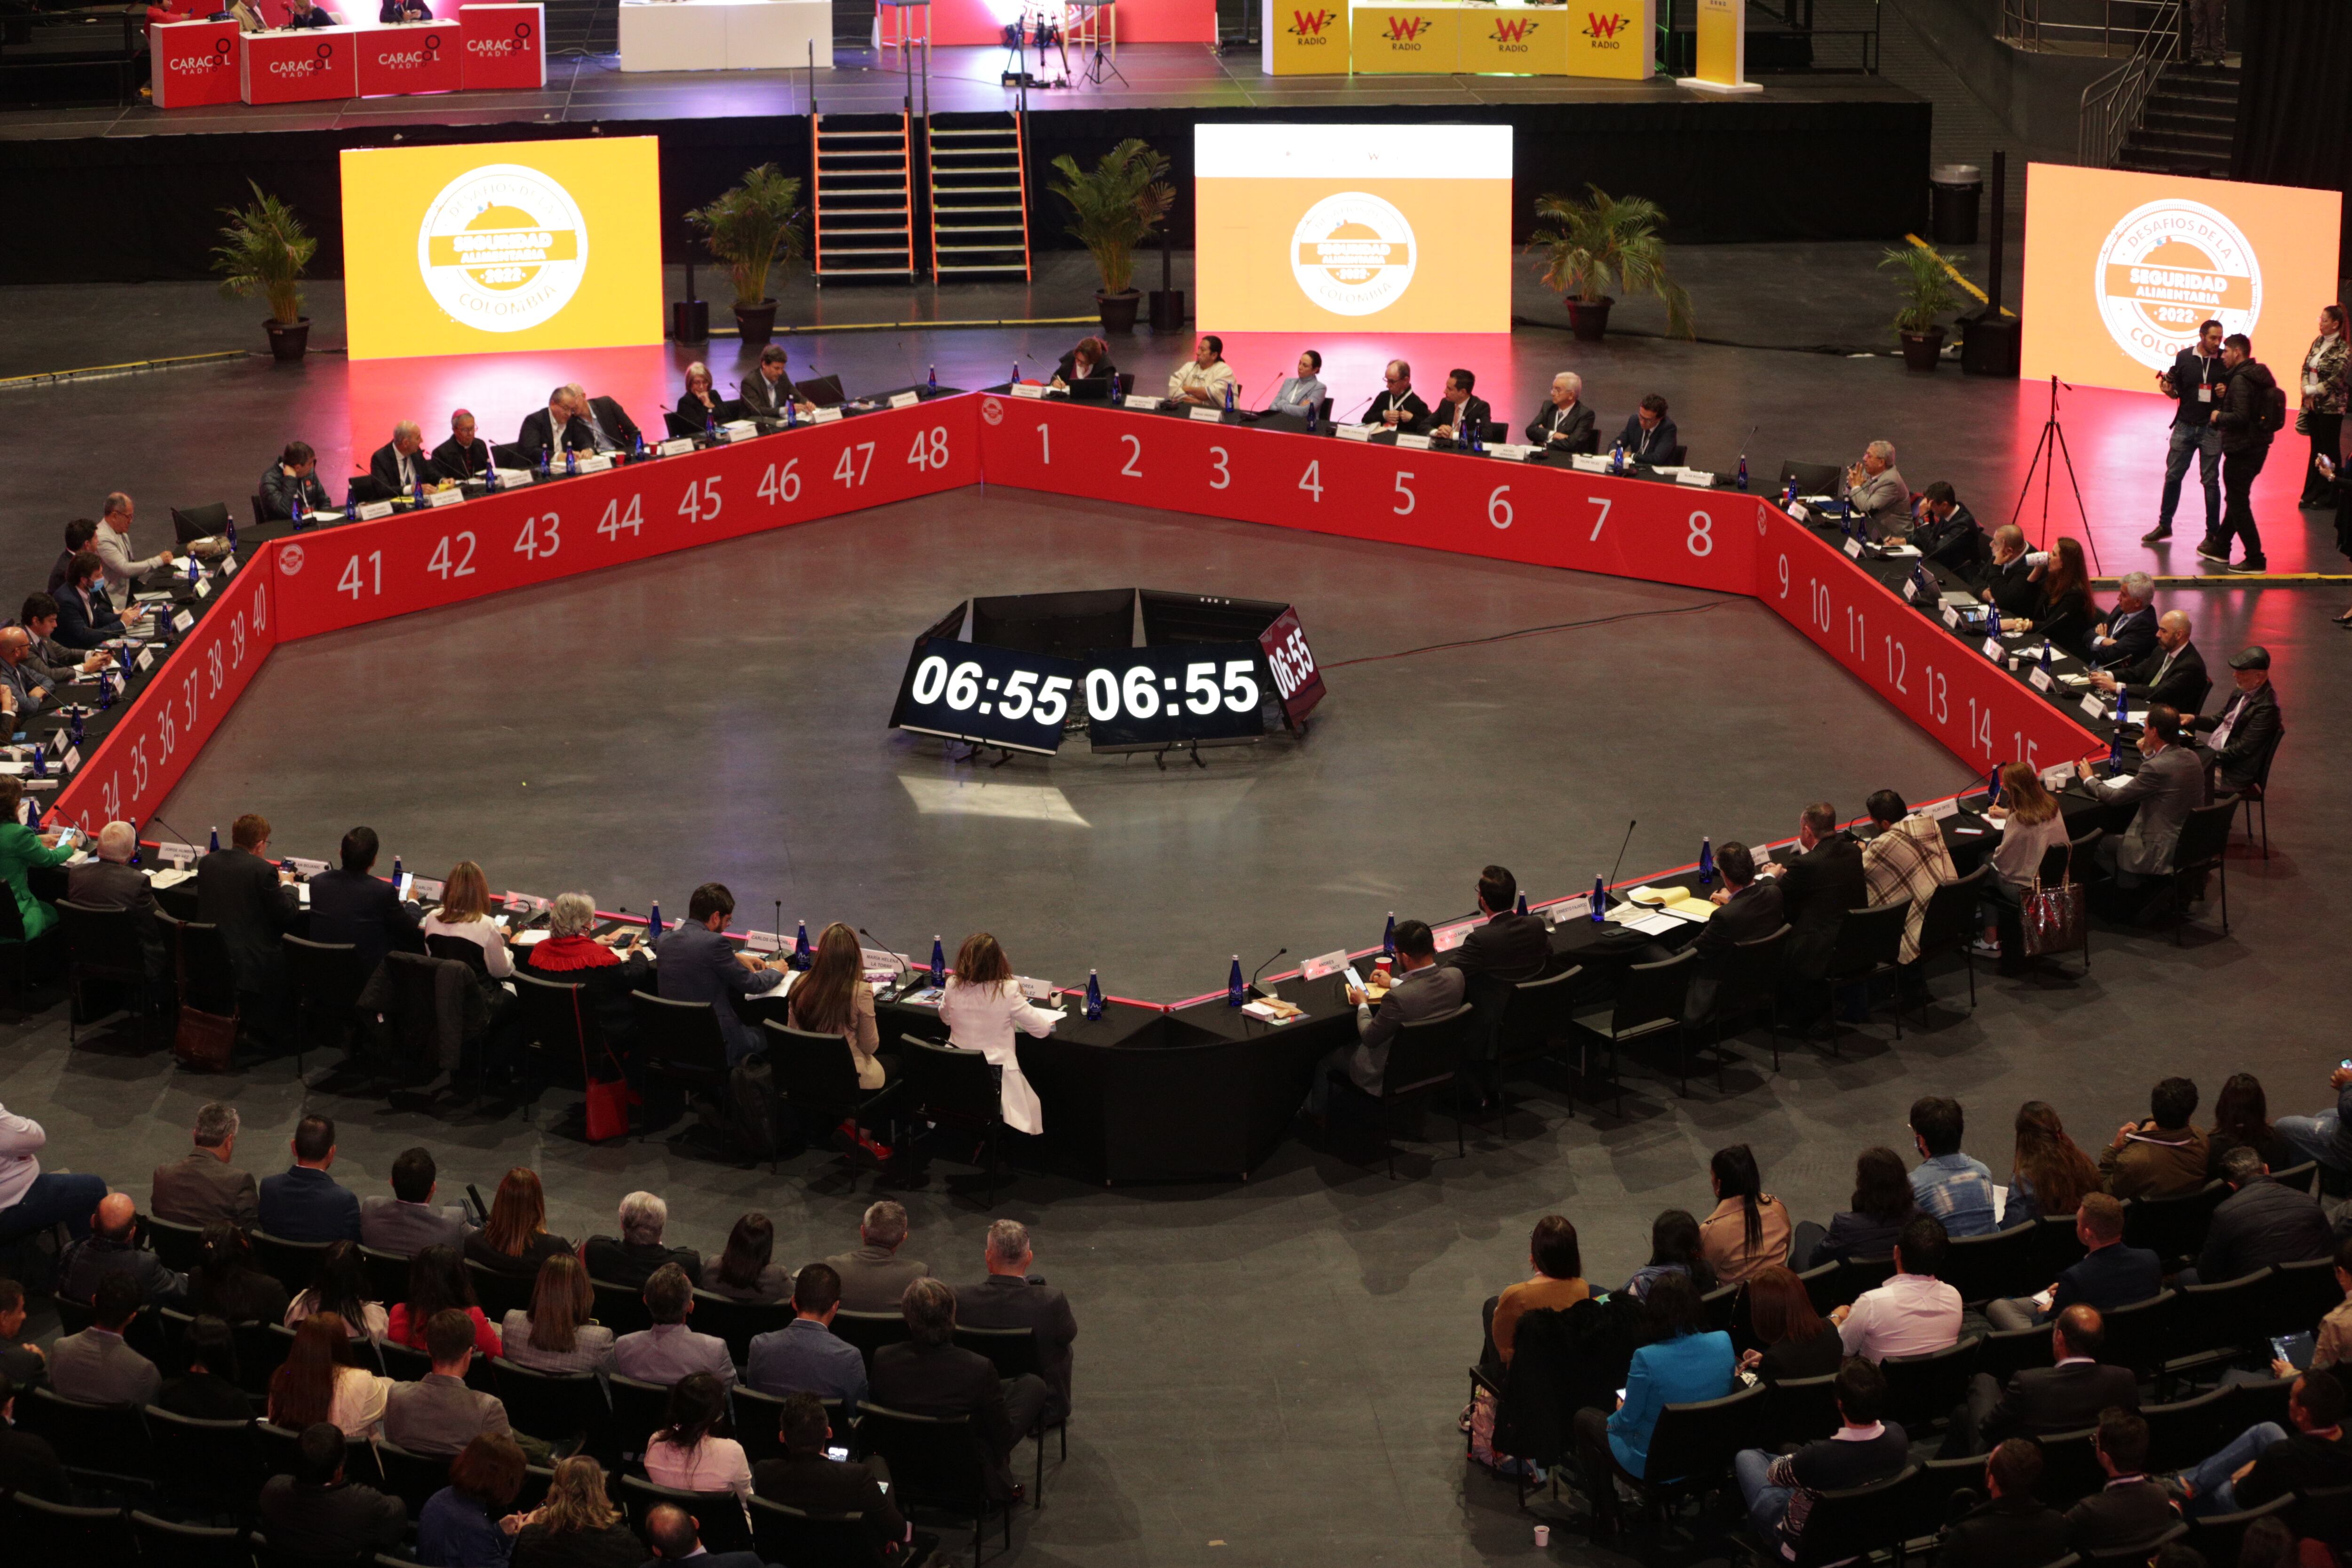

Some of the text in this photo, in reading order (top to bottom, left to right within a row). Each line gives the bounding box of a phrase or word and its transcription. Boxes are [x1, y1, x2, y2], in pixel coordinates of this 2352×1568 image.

[1294, 9, 1325, 35] W
[1298, 37, 1327, 46] RADIO
[1389, 16, 1421, 41] W
[1495, 18, 1527, 43] W
[1589, 12, 1620, 39] W
[170, 54, 230, 70] CARACOL
[270, 59, 332, 73] CARACOL
[379, 50, 440, 65] CARACOL
[467, 39, 530, 51] CARACOL
[1592, 40, 1620, 50] RADIO
[2198, 225, 2214, 240] DE
[2215, 237, 2233, 259] LA
[459, 285, 557, 315] COLOMBIA
[1320, 282, 1392, 303] COLOMBIA
[2130, 268, 2227, 293] SEGURIDAD
[2136, 286, 2220, 304] ALIMENTARIA
[2158, 307, 2194, 323] 2022
[834, 442, 875, 488] 47
[908, 427, 948, 471] 48
[1037, 424, 1049, 464] 1
[1121, 435, 1142, 477] 2
[757, 458, 800, 505] 46
[1209, 446, 1230, 489] 3
[1299, 460, 1323, 502] 4
[678, 476, 721, 523] 45
[1393, 471, 1415, 515] 5
[1488, 486, 1513, 529] 6
[514, 512, 560, 560] 43
[597, 493, 644, 541] 44
[1588, 497, 1611, 541] 7
[1687, 511, 1713, 557] 8
[337, 550, 381, 600] 41
[427, 531, 476, 580] 42
[1779, 554, 1788, 598] 9
[253, 582, 265, 636] 40
[1811, 578, 1830, 633] 10
[230, 611, 245, 669] 39
[1847, 606, 1865, 661] 11
[207, 639, 222, 700] 38
[1270, 628, 1313, 700] 06:55
[1885, 635, 1907, 694] 12
[183, 668, 198, 731] 37
[913, 656, 1073, 725] 06:55
[1086, 661, 1259, 721] 06:55
[1926, 666, 1947, 724] 13
[158, 700, 175, 765] 36
[1969, 698, 1992, 759] 14
[131, 734, 147, 801] 35
[103, 770, 120, 823] 34
